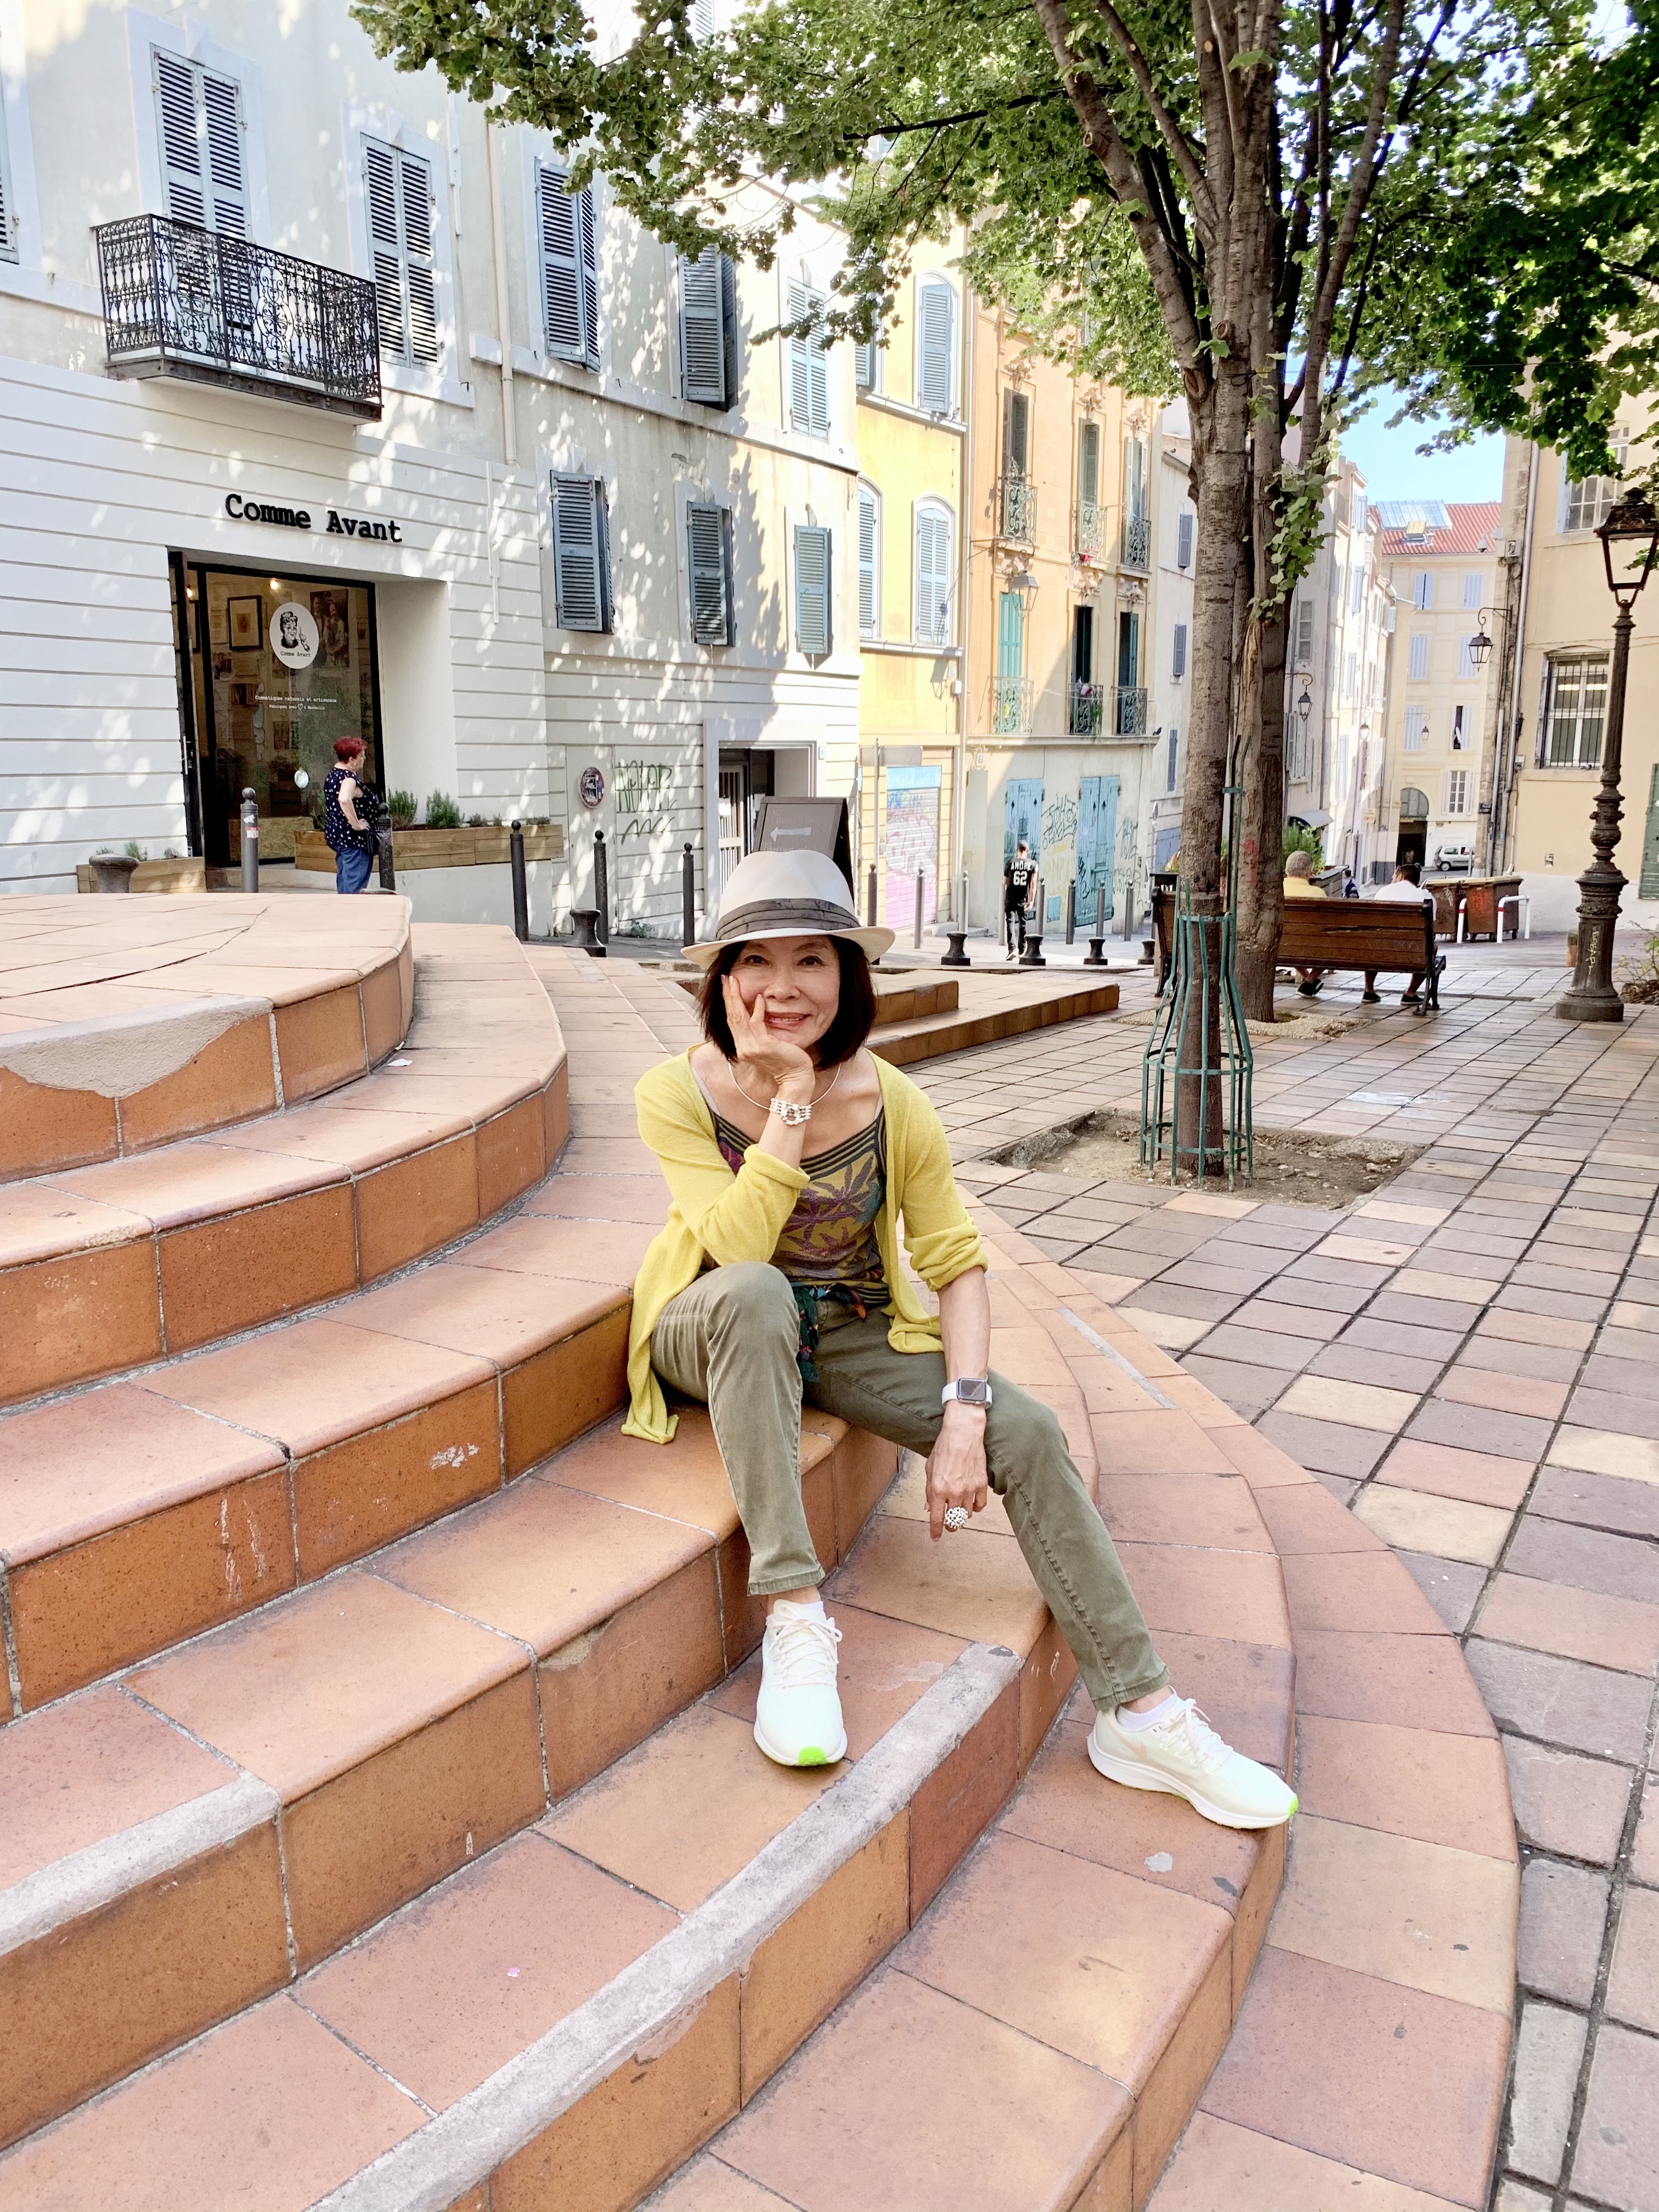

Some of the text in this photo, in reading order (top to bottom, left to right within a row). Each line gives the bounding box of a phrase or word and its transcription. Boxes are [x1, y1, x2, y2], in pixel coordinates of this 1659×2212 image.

[225, 494, 402, 542] Comme Avant
[1013, 871, 1028, 885] 62
